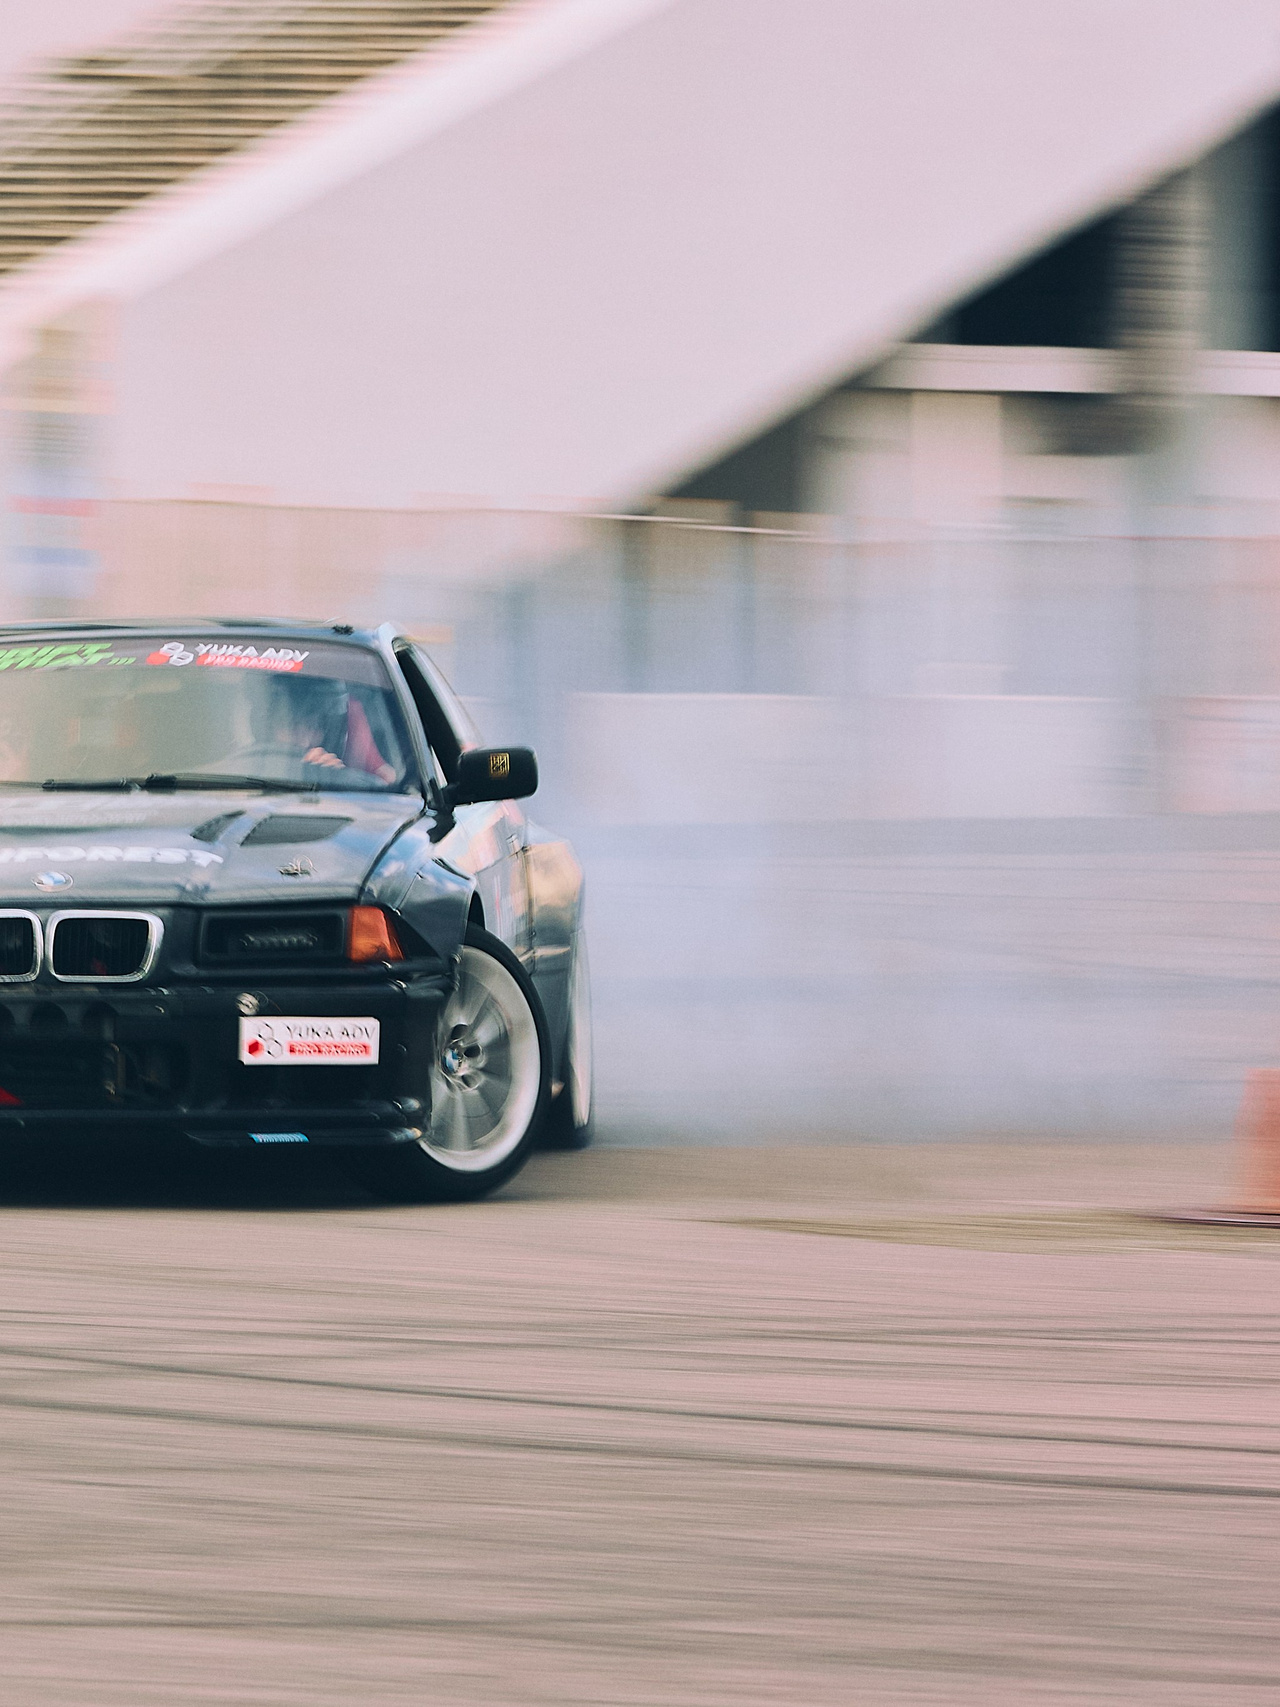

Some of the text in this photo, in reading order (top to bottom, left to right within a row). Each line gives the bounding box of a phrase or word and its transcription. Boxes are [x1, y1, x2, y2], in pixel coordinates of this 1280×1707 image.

[195, 643, 309, 662] YUKA ADV
[283, 1023, 376, 1040] YUKA ADV
